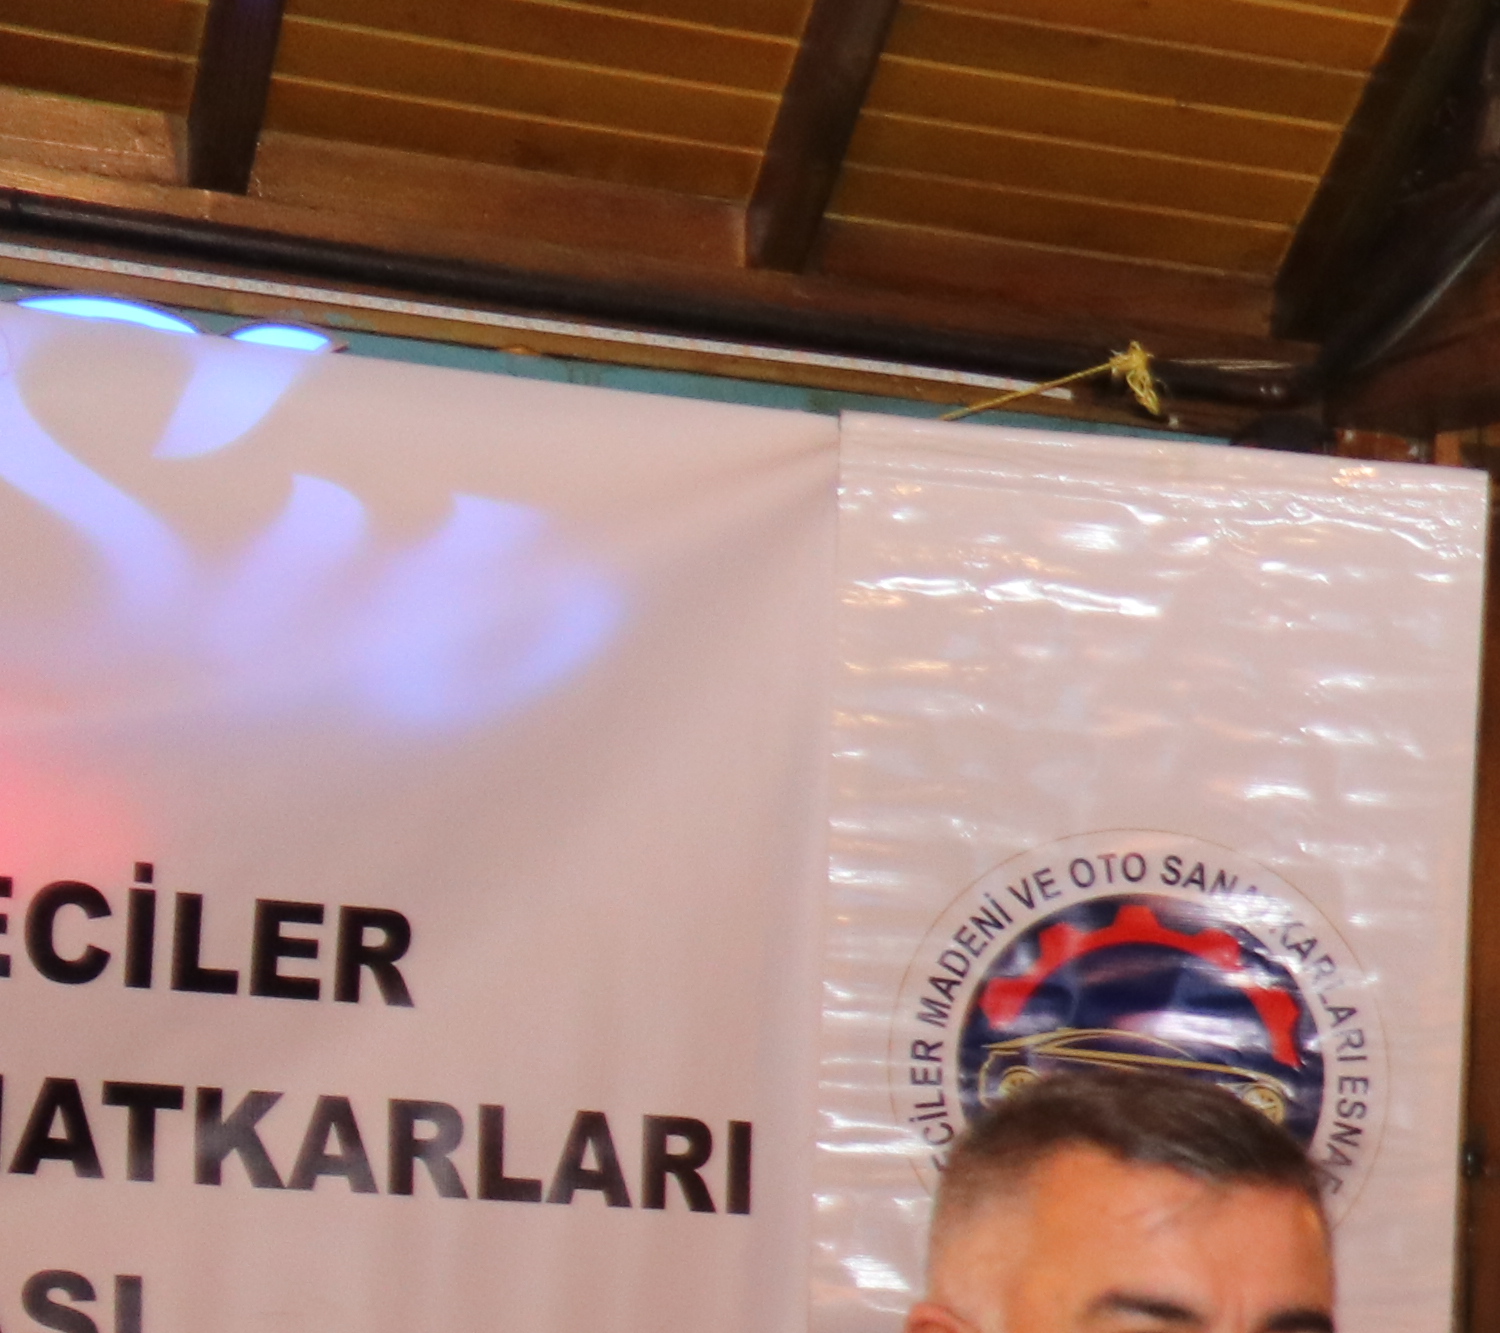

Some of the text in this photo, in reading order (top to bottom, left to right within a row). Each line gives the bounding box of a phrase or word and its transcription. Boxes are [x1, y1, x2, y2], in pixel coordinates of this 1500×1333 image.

[0, 862, 414, 1007] CİLER
[917, 892, 1014, 1028] MADENİ
[1008, 867, 1061, 911] VE
[1069, 852, 1148, 889] OTO
[0, 1074, 752, 1215] ATKARLARI
